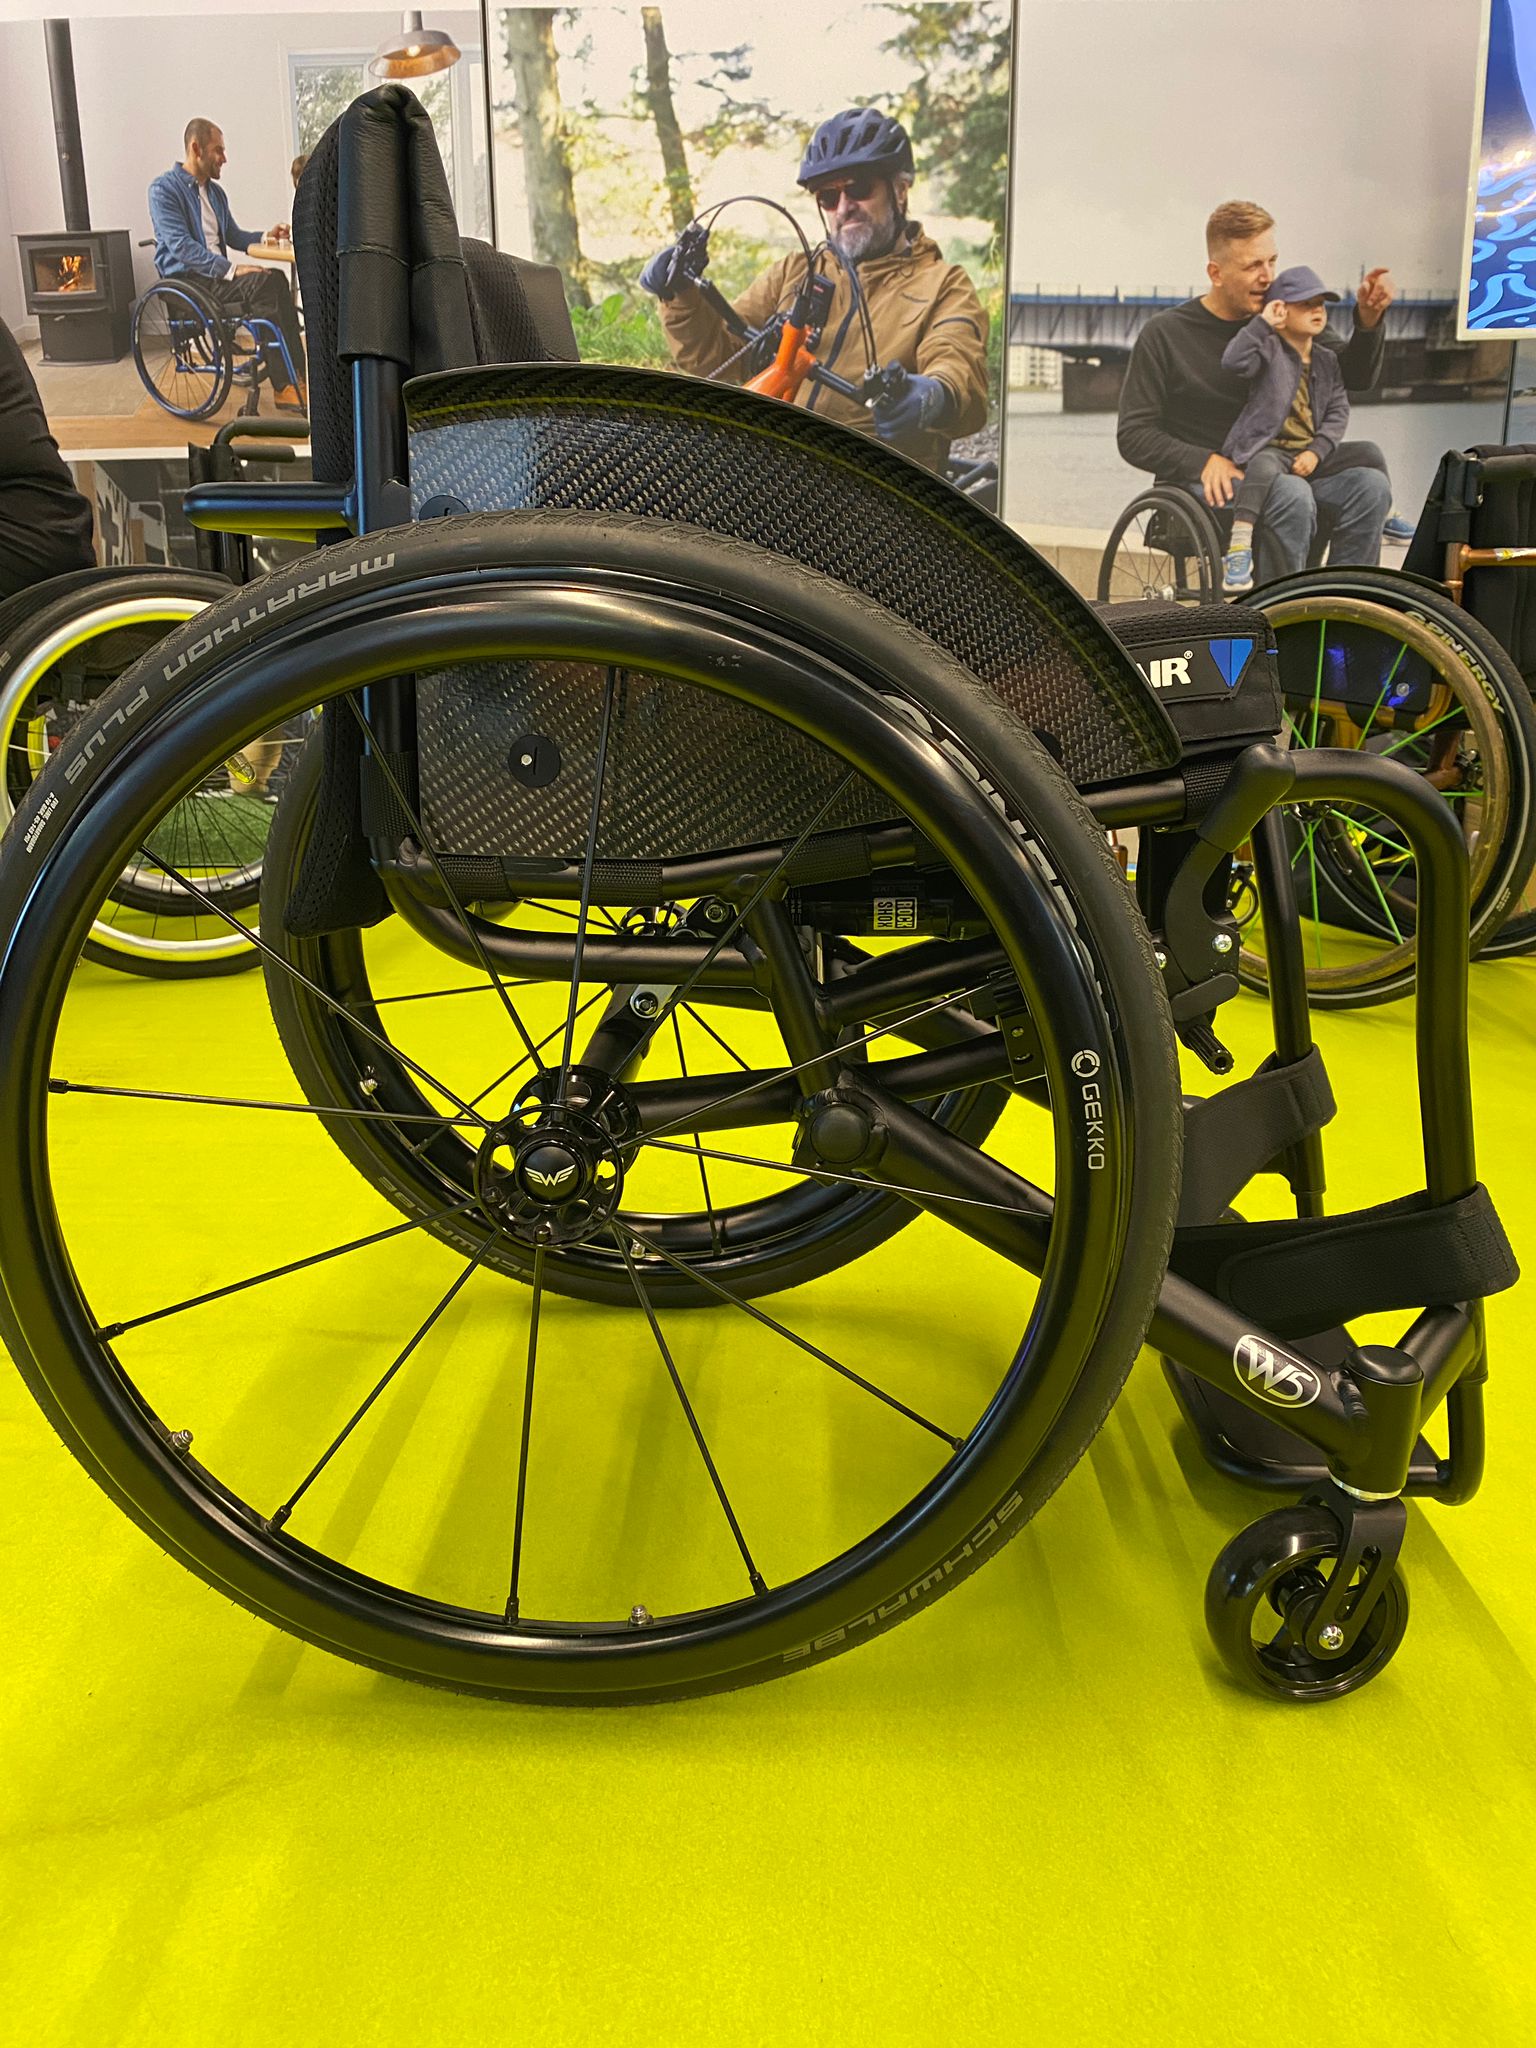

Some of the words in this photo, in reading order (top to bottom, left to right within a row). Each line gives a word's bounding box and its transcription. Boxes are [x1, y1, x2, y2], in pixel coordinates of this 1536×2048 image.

[163, 553, 395, 681] MARATHON
[64, 686, 150, 785] PLUS
[877, 901, 893, 928] SHOX
[897, 901, 913, 928] ROCK
[1082, 1083, 1105, 1170] GEKKO
[1240, 1340, 1314, 1401] W5
[783, 1490, 1024, 1663] SCHWALBE
